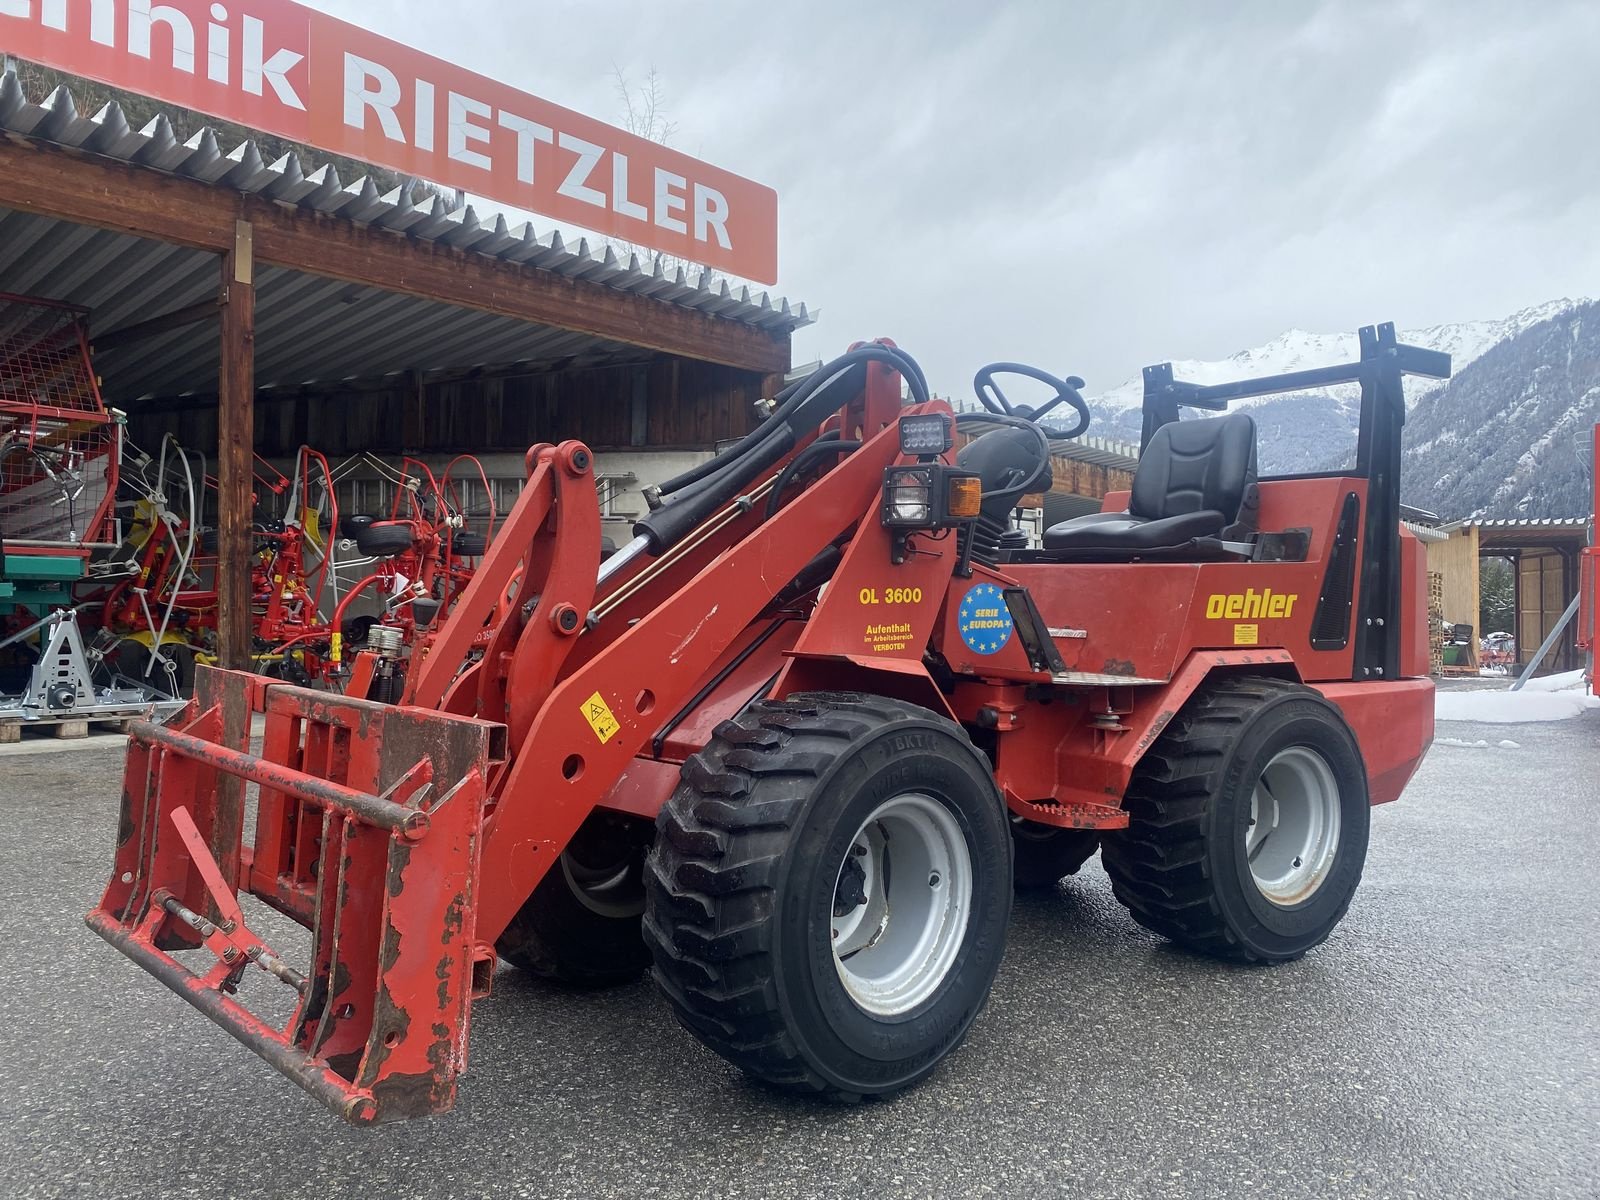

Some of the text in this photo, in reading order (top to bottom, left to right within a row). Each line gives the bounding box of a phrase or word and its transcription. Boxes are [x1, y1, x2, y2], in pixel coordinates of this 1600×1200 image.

[343, 51, 733, 251] RIETZLER
[860, 588, 922, 604] OL 3600
[1206, 588, 1298, 619] oehler
[975, 608, 999, 618] SERIE
[866, 623, 911, 635] Aufenthalt
[969, 619, 1004, 629] EUROPA
[873, 633, 914, 642] Arbeitsbereich
[873, 643, 905, 652] VERBOTEN
[895, 735, 924, 751] BKT
